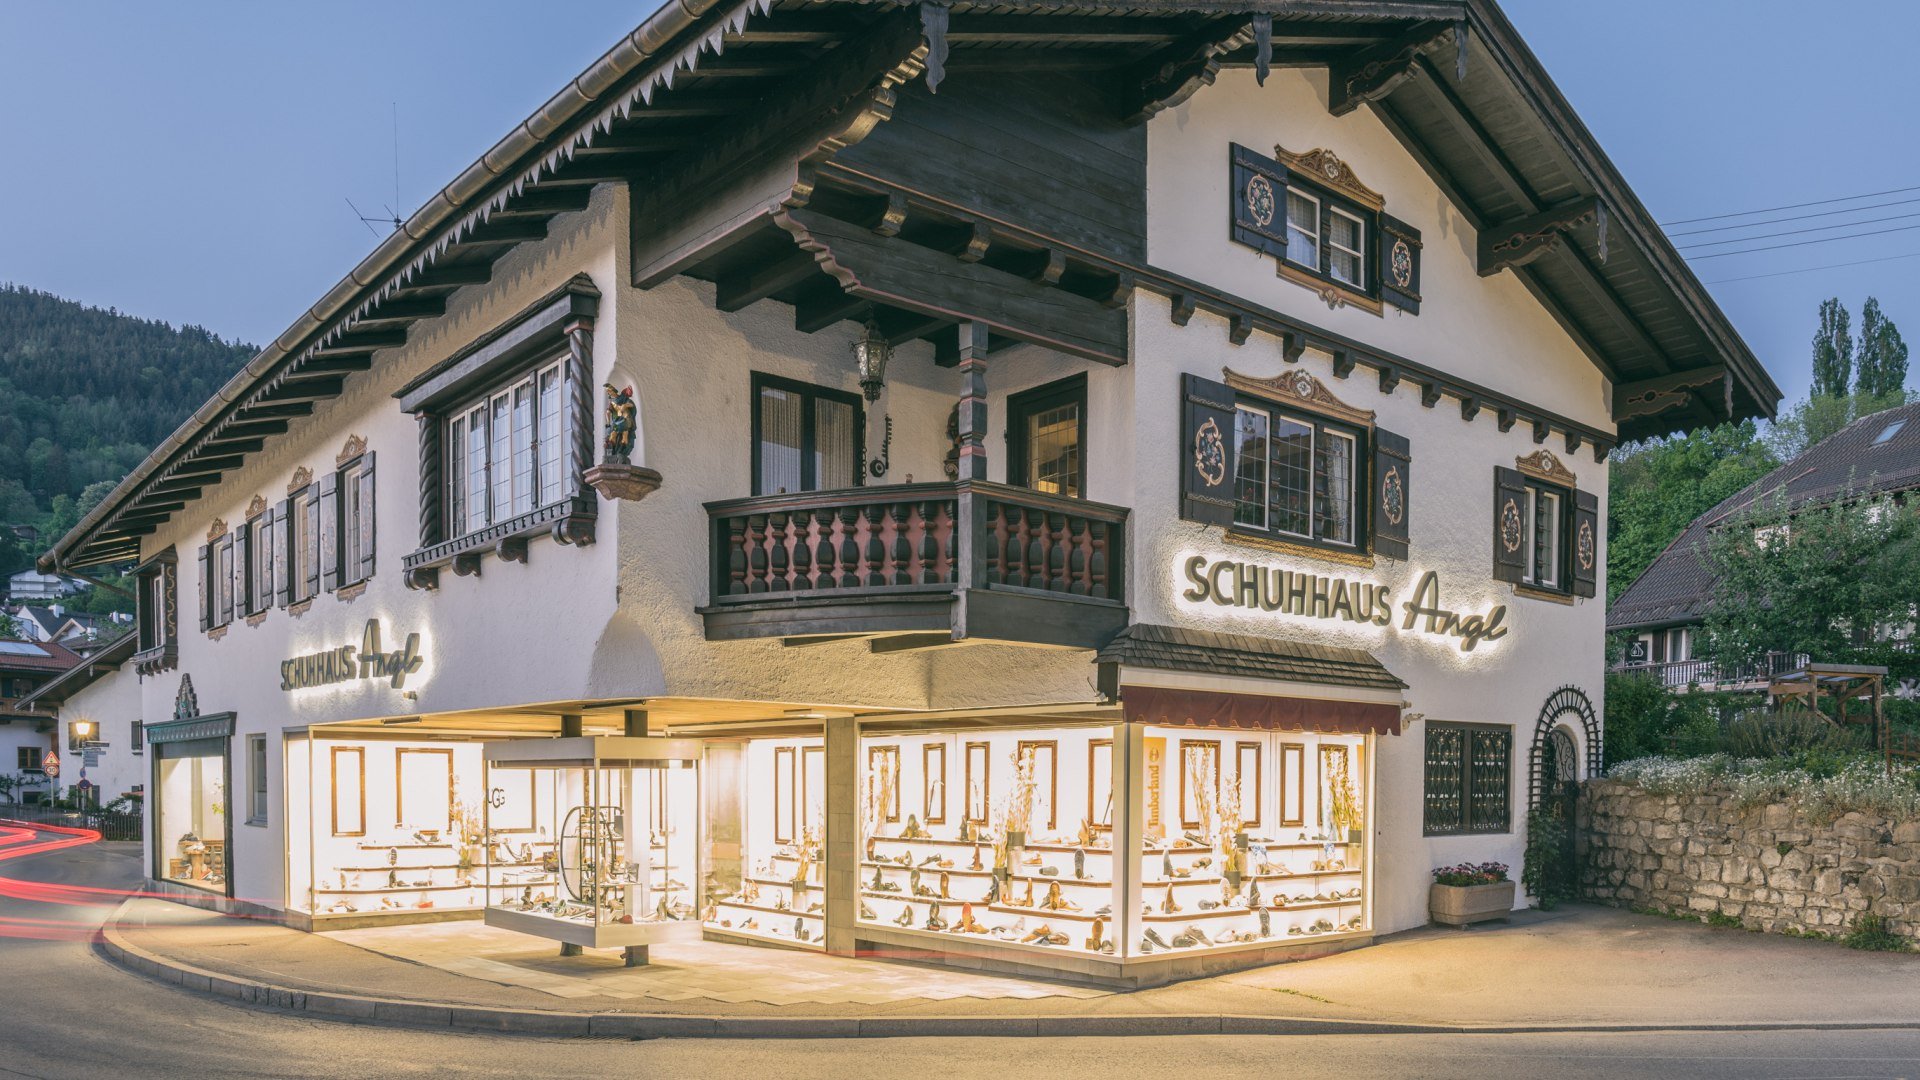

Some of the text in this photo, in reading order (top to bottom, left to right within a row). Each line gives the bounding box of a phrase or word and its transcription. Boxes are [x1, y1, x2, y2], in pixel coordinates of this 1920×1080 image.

[1183, 555, 1508, 651] SCHUHHAUS Angl
[281, 618, 423, 691] SCHUHHAUS Angl
[1148, 765, 1160, 829] Timberland
